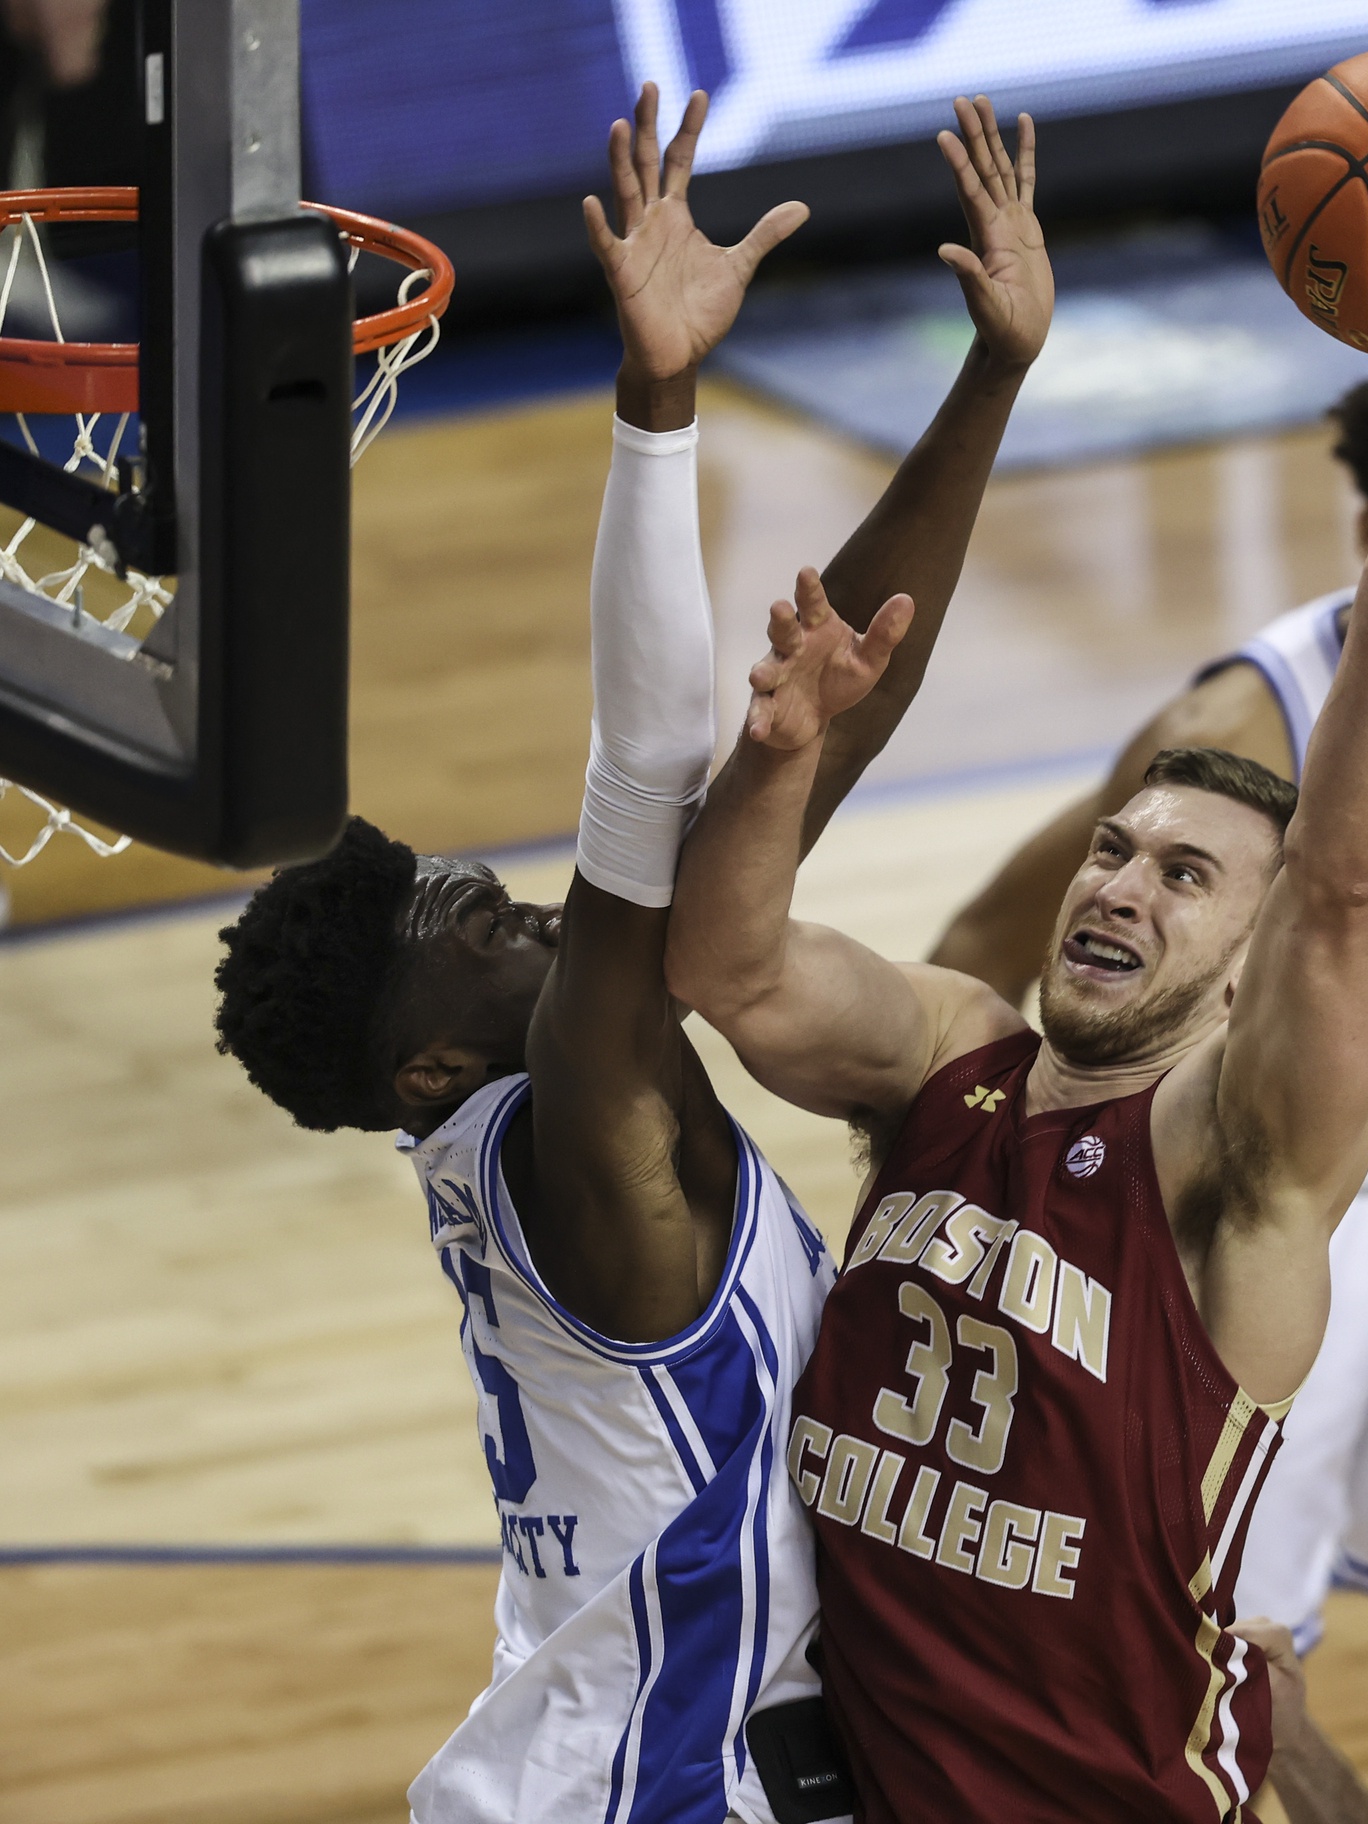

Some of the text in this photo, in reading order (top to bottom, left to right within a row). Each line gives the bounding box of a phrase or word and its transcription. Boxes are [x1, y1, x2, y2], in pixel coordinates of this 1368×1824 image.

[1069, 1145, 1104, 1161] ACC
[843, 1189, 1112, 1383] BOSTON
[872, 1280, 1019, 1475] 33
[786, 1414, 1087, 1600] COLLEGE
